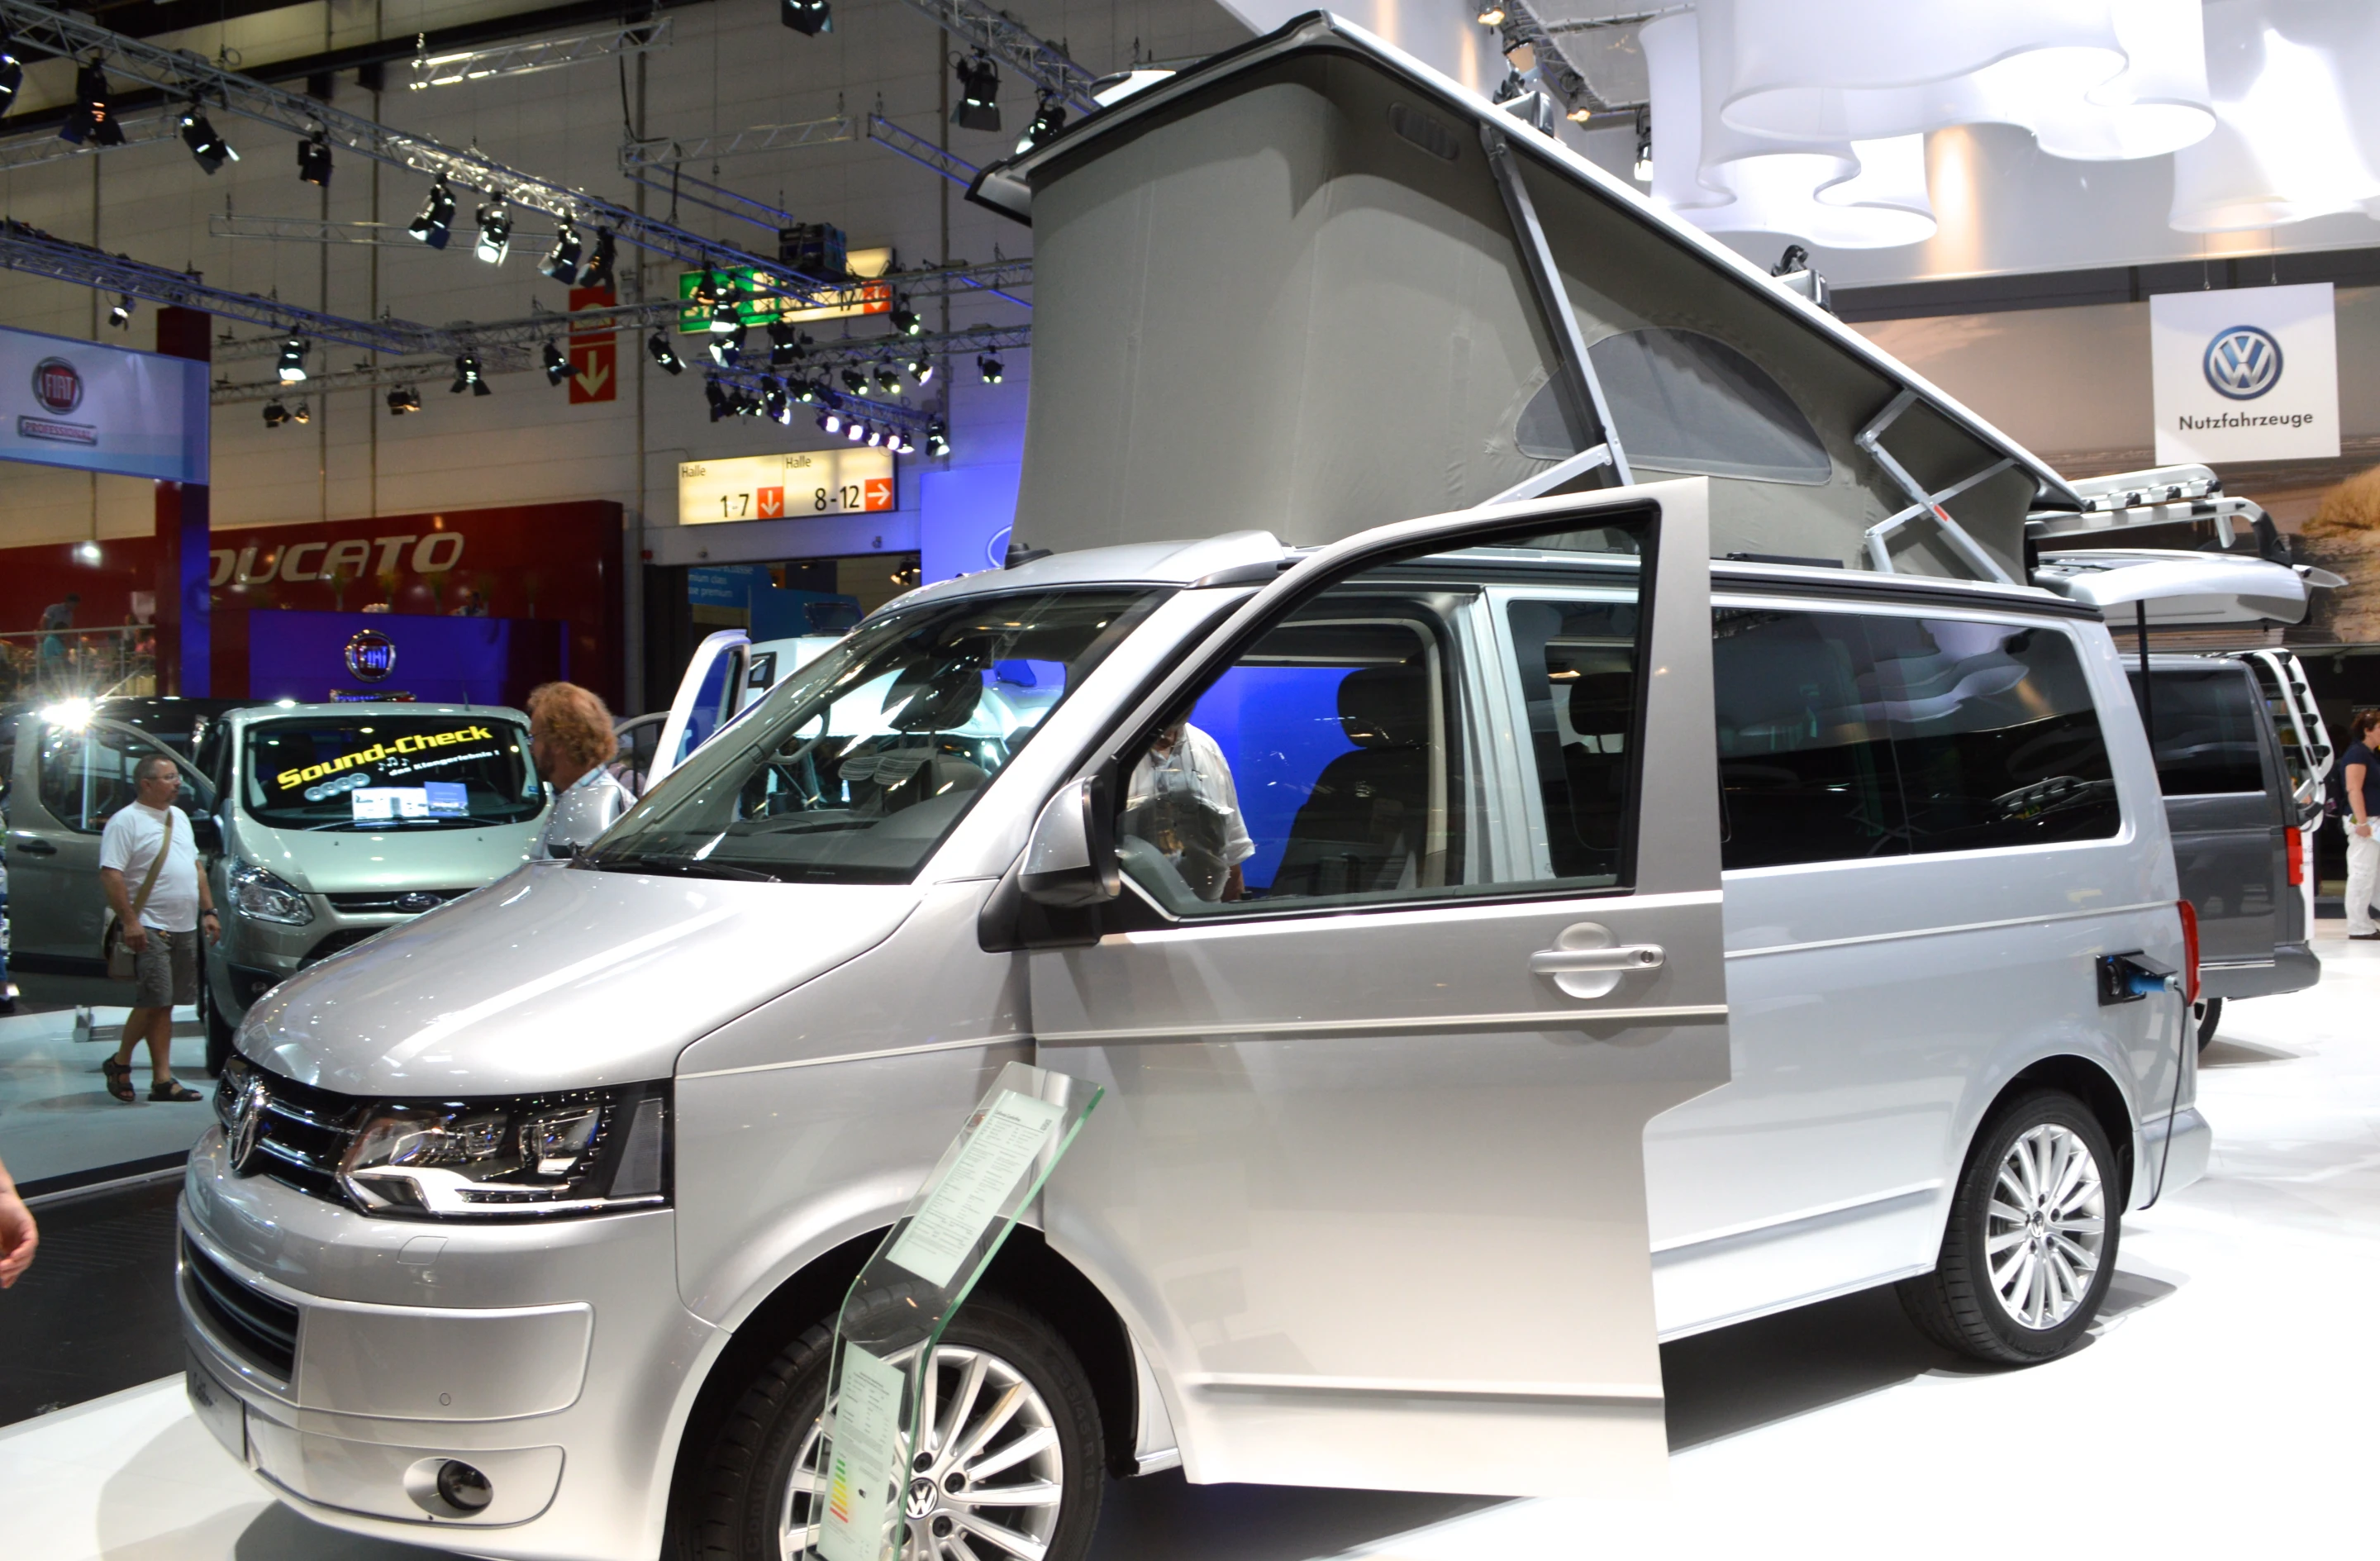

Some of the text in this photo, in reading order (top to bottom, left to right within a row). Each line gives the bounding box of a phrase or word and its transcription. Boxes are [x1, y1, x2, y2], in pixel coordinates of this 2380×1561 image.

[45, 374, 73, 400] FIAT
[2179, 412, 2314, 431] Nutzfahrzeuge
[681, 465, 706, 478] Halle
[786, 455, 812, 469] Halle
[277, 726, 493, 790] Sound-Check
